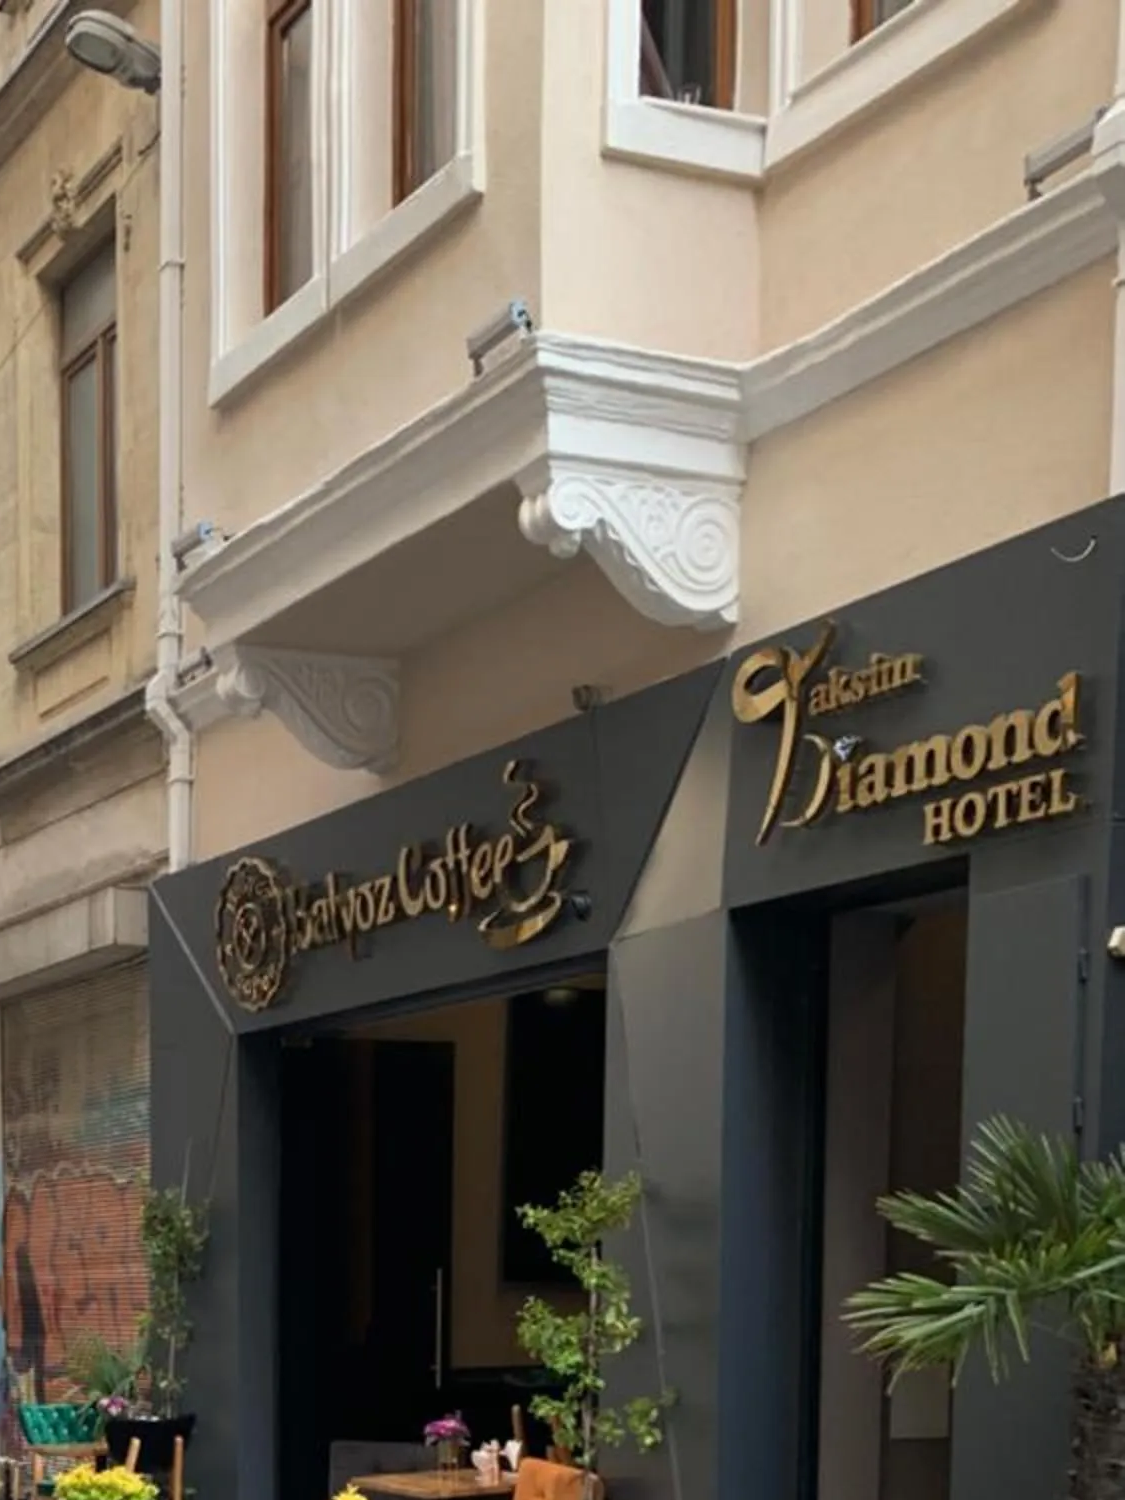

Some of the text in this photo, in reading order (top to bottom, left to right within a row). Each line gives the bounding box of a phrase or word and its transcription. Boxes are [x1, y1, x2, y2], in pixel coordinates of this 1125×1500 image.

[732, 618, 927, 846] Taksim
[770, 670, 1086, 832] Diamond
[398, 822, 513, 922] Coffee
[923, 768, 1083, 846] HOTEL
